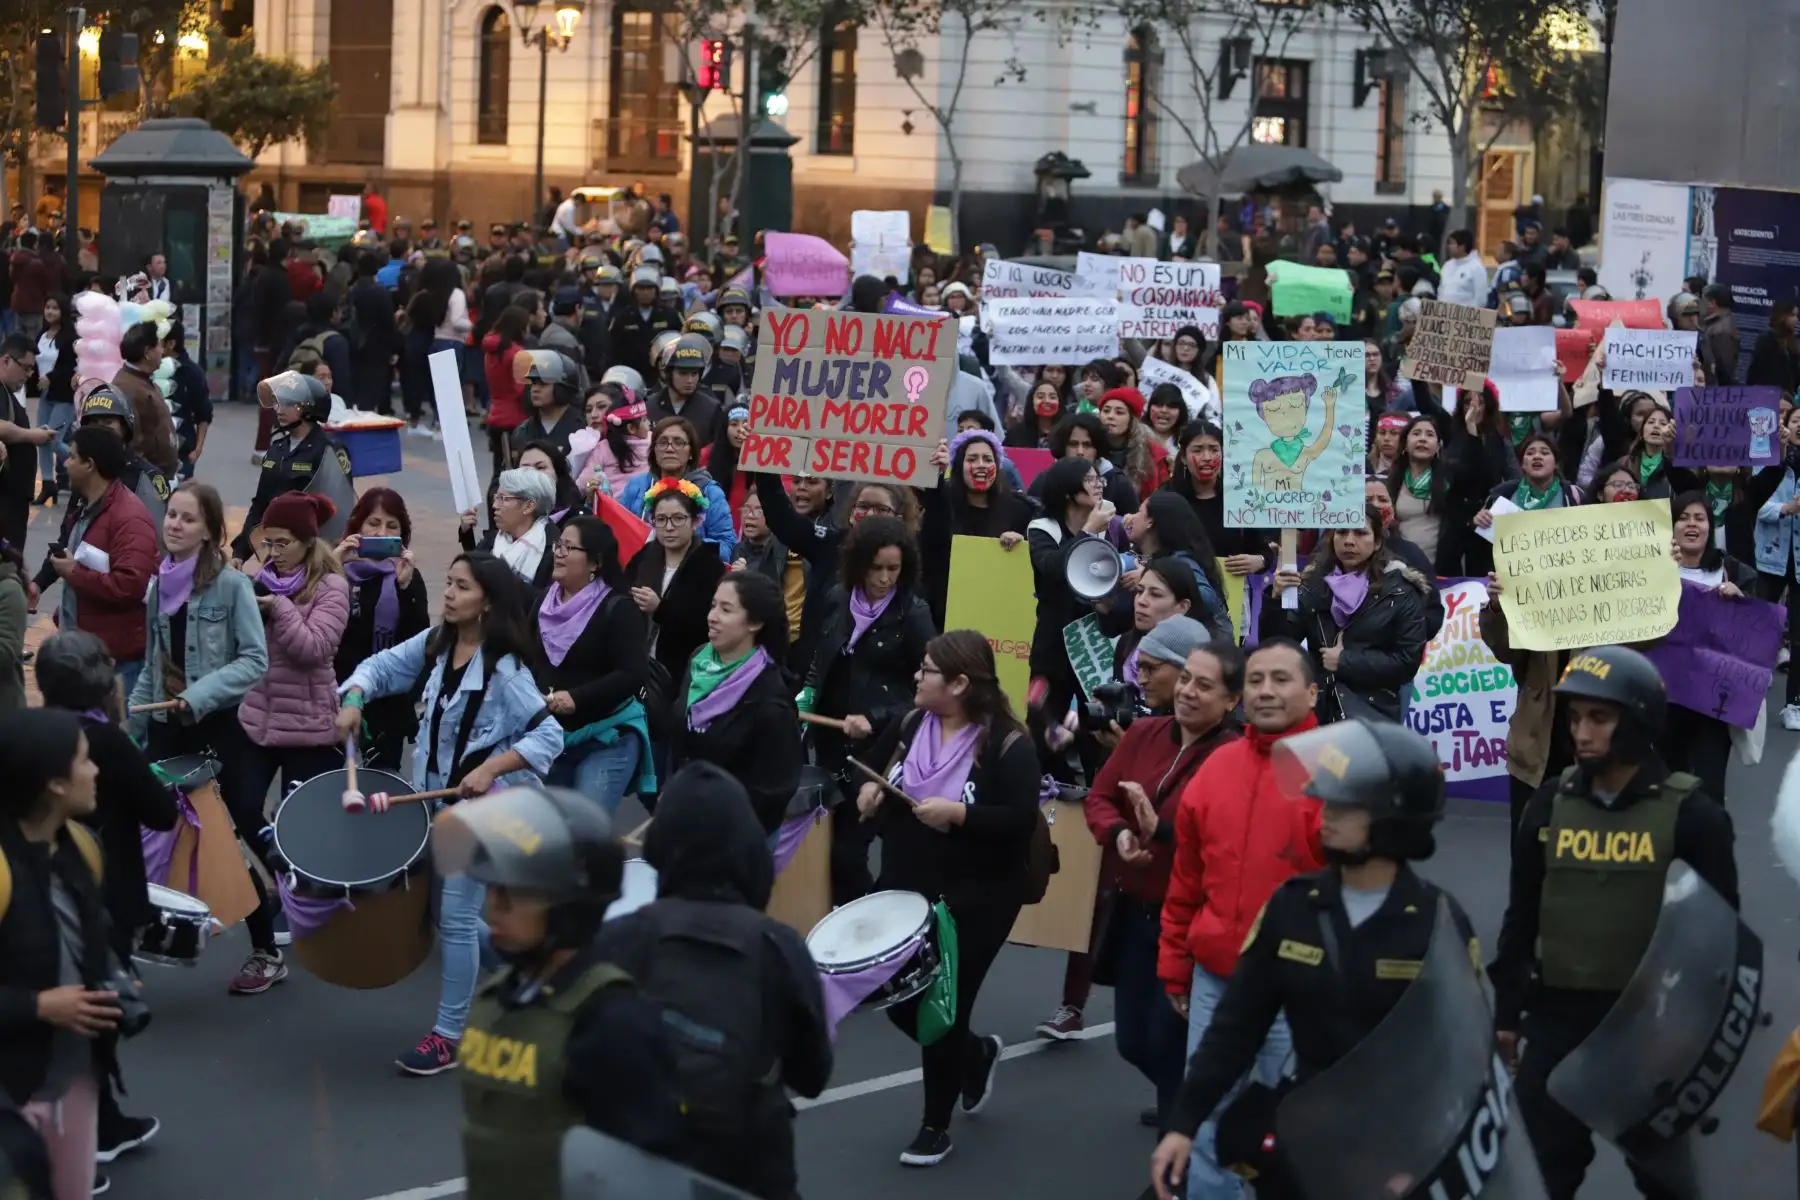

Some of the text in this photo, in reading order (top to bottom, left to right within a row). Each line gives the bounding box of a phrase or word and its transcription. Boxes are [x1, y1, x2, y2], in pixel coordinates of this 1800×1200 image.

[1034, 271, 1072, 290] usas
[1121, 264, 1145, 284] NO
[1153, 265, 1173, 285] ES
[999, 306, 1030, 316] TENGO
[1055, 306, 1089, 316] MADRE
[768, 311, 953, 362] YO NO NACI
[1608, 342, 1692, 360] MACHISTA
[1226, 344, 1246, 361] Mi
[1257, 345, 1317, 358] VIDA
[1257, 360, 1332, 373] VALOR
[772, 358, 891, 400] MUJER
[1611, 368, 1684, 385] FEMINISTA
[750, 394, 929, 438] PARA MORIR
[741, 434, 916, 480] POR SERLO
[1275, 477, 1291, 490] Mi
[1227, 508, 1256, 525] NO
[1500, 520, 1656, 554] LAS PAREDES SE LIMPIAN
[1508, 541, 1662, 577] LAS COSAS SE ARREGLAN
[1515, 569, 1647, 606] LA VIDA DE NUESTRAS
[1445, 592, 1467, 619] Y
[1514, 594, 1667, 632] HERMANAS NO REGRESA
[1490, 700, 1507, 723] E
[1556, 829, 1655, 863] POLICIA
[459, 1026, 538, 1088] POLICIA
[1649, 964, 1762, 1140] POLICIA
